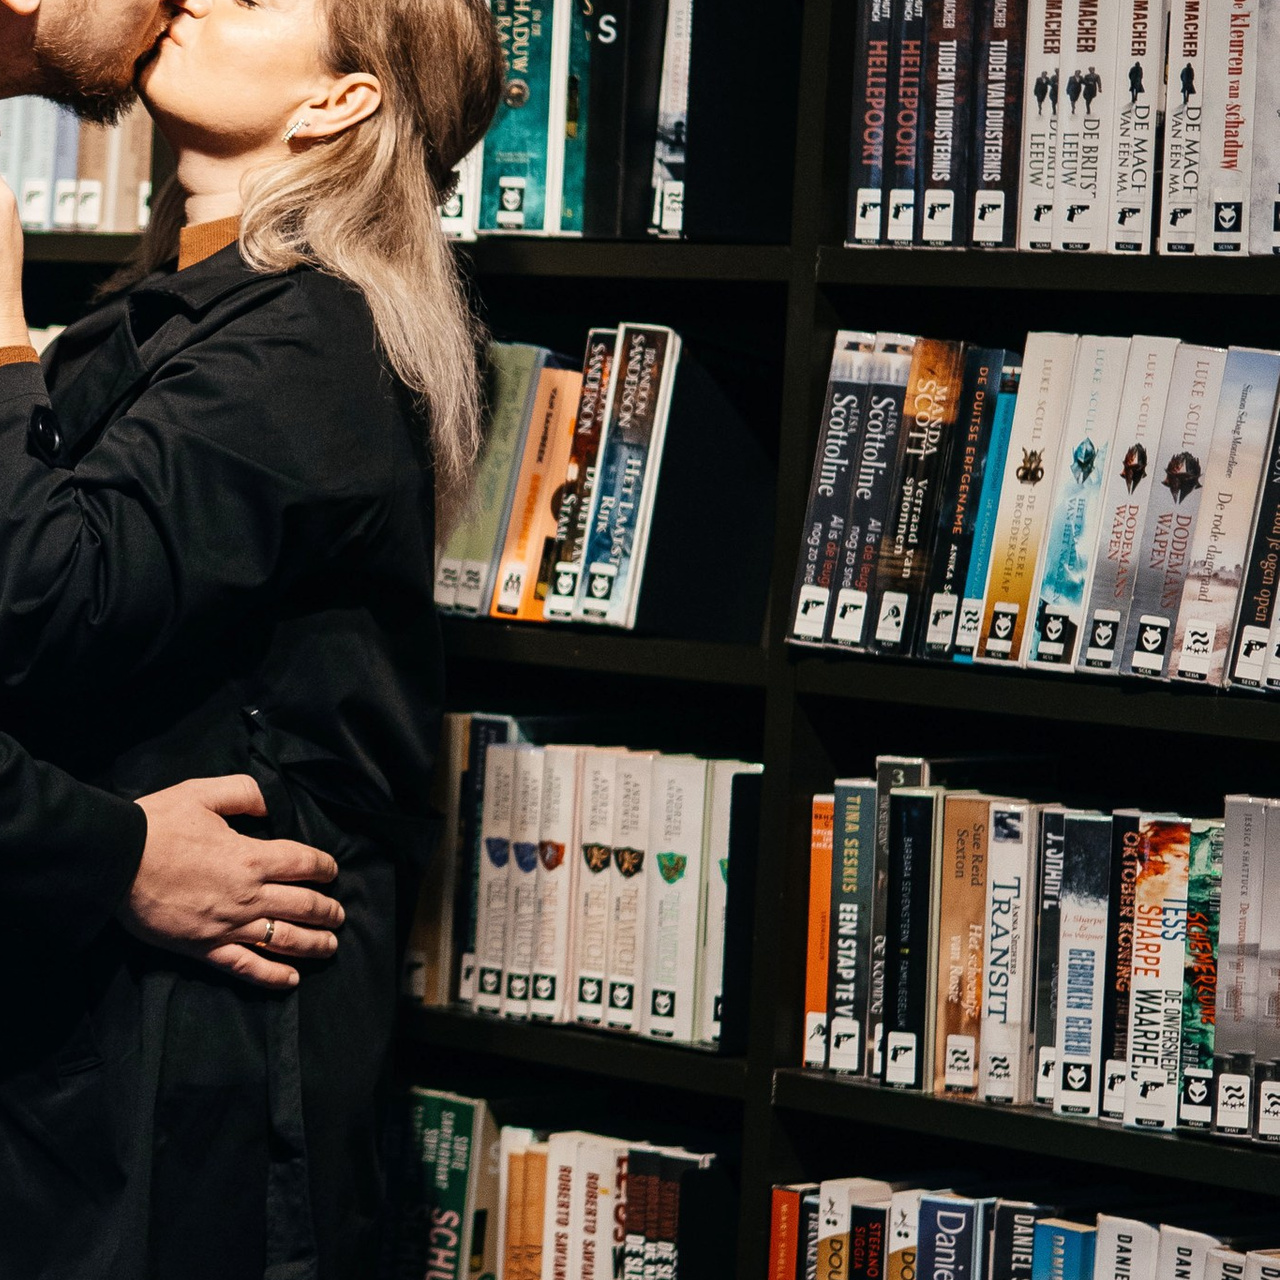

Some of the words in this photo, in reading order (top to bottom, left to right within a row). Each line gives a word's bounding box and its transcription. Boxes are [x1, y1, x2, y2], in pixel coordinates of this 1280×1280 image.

[1227, 10, 1251, 76] kleuren
[861, 40, 888, 166] HELLEPOORT
[894, 40, 921, 169] HELLEPOORT
[934, 84, 955, 108] VAN
[986, 84, 1006, 108] VAN
[1227, 79, 1240, 99] van
[1083, 118, 1101, 140] DE
[1119, 110, 1132, 138] VAN
[1134, 105, 1151, 131] DE
[1171, 111, 1184, 139] VAN
[1185, 106, 1202, 132] DE
[1218, 103, 1246, 175] schaduw
[931, 110, 953, 182] DUISTERNIS
[982, 109, 1005, 182] DUISTERNIS
[1028, 133, 1046, 188] LEEUW
[1061, 132, 1079, 188] LEEUW
[577, 341, 606, 434] SANDERSON
[618, 333, 644, 430] SANDERSON
[635, 347, 656, 417] BRANDON
[1039, 358, 1053, 397] LUKE
[1092, 348, 1105, 384] LUKE
[1142, 352, 1156, 389] LUKE
[1191, 360, 1210, 398] LUKE
[906, 378, 934, 460] SCOTT
[924, 385, 949, 456] MANDA
[968, 390, 986, 441] DUITSE
[1031, 400, 1047, 443] SCULL
[1084, 391, 1098, 433] SCULL
[1135, 396, 1150, 440] SCULL
[1182, 404, 1200, 448] SCULL
[818, 392, 859, 498] Scottoline
[855, 395, 896, 501] Scottoline
[621, 459, 642, 495] HET
[952, 446, 976, 535] ERFGENAME
[1217, 492, 1233, 512] De
[556, 493, 577, 542] STAAL
[596, 495, 615, 533] RIJK
[893, 477, 915, 555] spionnen
[907, 478, 928, 544] Verraad
[1108, 504, 1127, 560] WAPEN
[1210, 514, 1229, 541] rode
[901, 549, 915, 579] van
[1001, 494, 1025, 593] BROEDERSCHAP
[1149, 513, 1174, 569] WAPEN
[1161, 514, 1192, 611] DODEMANS
[1253, 588, 1272, 623] open
[891, 768, 905, 786] 3
[844, 795, 861, 833] TINA
[841, 838, 860, 894] SESKIS
[837, 903, 859, 935] EEN
[1133, 904, 1163, 978] SHARPE
[836, 937, 857, 980] STAP
[987, 876, 1021, 1025] TRANSIT
[1011, 1214, 1035, 1271] DANIEL
